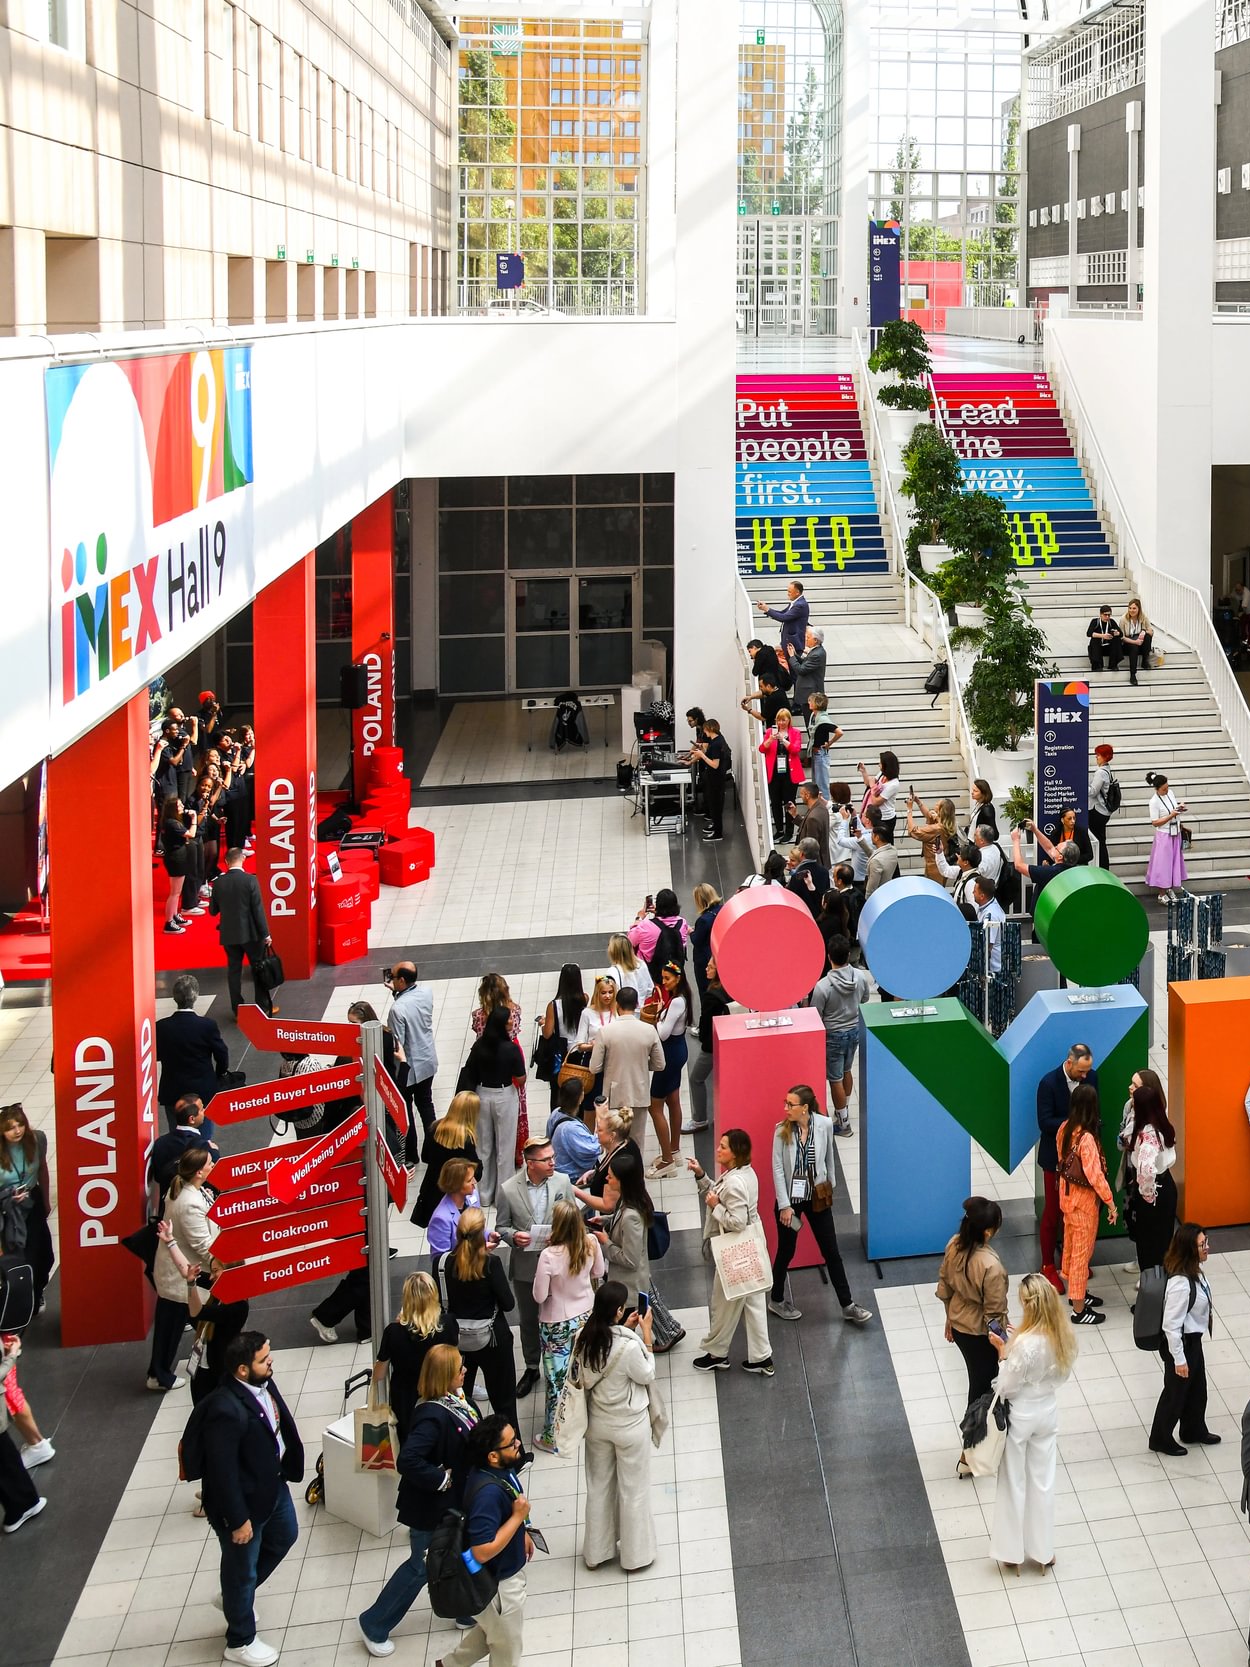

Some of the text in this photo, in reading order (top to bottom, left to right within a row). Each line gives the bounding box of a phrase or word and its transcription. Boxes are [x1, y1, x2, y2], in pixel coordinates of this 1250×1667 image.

[736, 398, 793, 427] Put
[938, 396, 1020, 425] Lead
[740, 431, 852, 470] people
[948, 429, 1003, 458] the
[742, 473, 822, 505] first.
[960, 469, 1036, 499] way.
[752, 516, 855, 572] KEEP
[167, 524, 210, 633] Hall
[213, 520, 226, 597] 9
[362, 653, 383, 756] POLAND
[269, 777, 297, 917] POLAND
[276, 1028, 336, 1043] Registration
[229, 1077, 351, 1112] Hosted Buyer Lounge
[74, 1036, 119, 1248] POLAND
[291, 1144, 334, 1185] Well-being
[334, 1118, 363, 1149] Lounge
[231, 1161, 262, 1178] IMEX
[310, 1181, 340, 1195] Drop
[216, 1195, 279, 1218] Lufthansa
[262, 1219, 329, 1242] Cloakroom
[263, 1256, 331, 1282] Food Court
